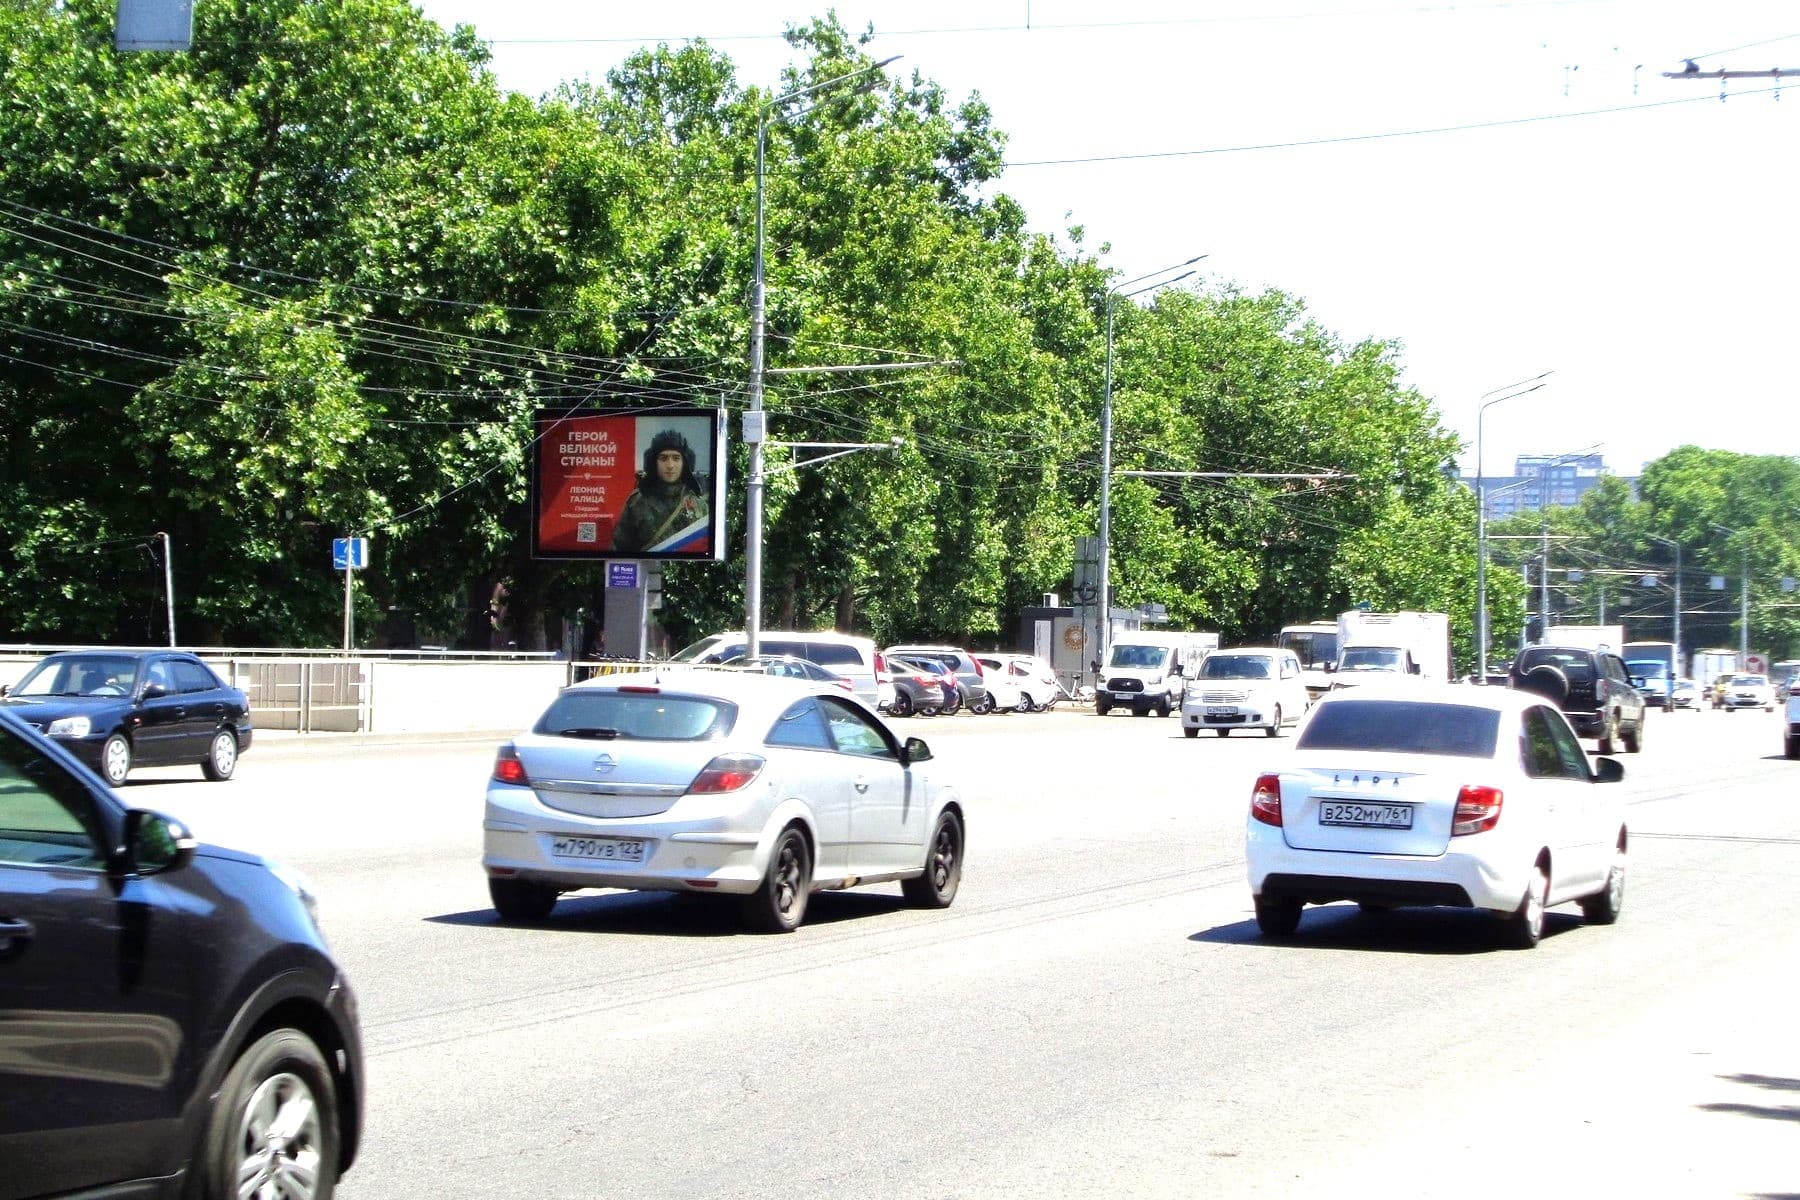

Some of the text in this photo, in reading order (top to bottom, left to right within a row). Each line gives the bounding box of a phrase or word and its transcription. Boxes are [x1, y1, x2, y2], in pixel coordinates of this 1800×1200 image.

[568, 431, 608, 441] ГЕРОИ
[559, 441, 617, 454] ВЕЛИКОЙ
[560, 456, 615, 466] СТРАНЫ!
[569, 486, 605, 495] ЛЕОНИД
[569, 495, 605, 504] ГАЛИЦА
[1334, 774, 1400, 785] LADA
